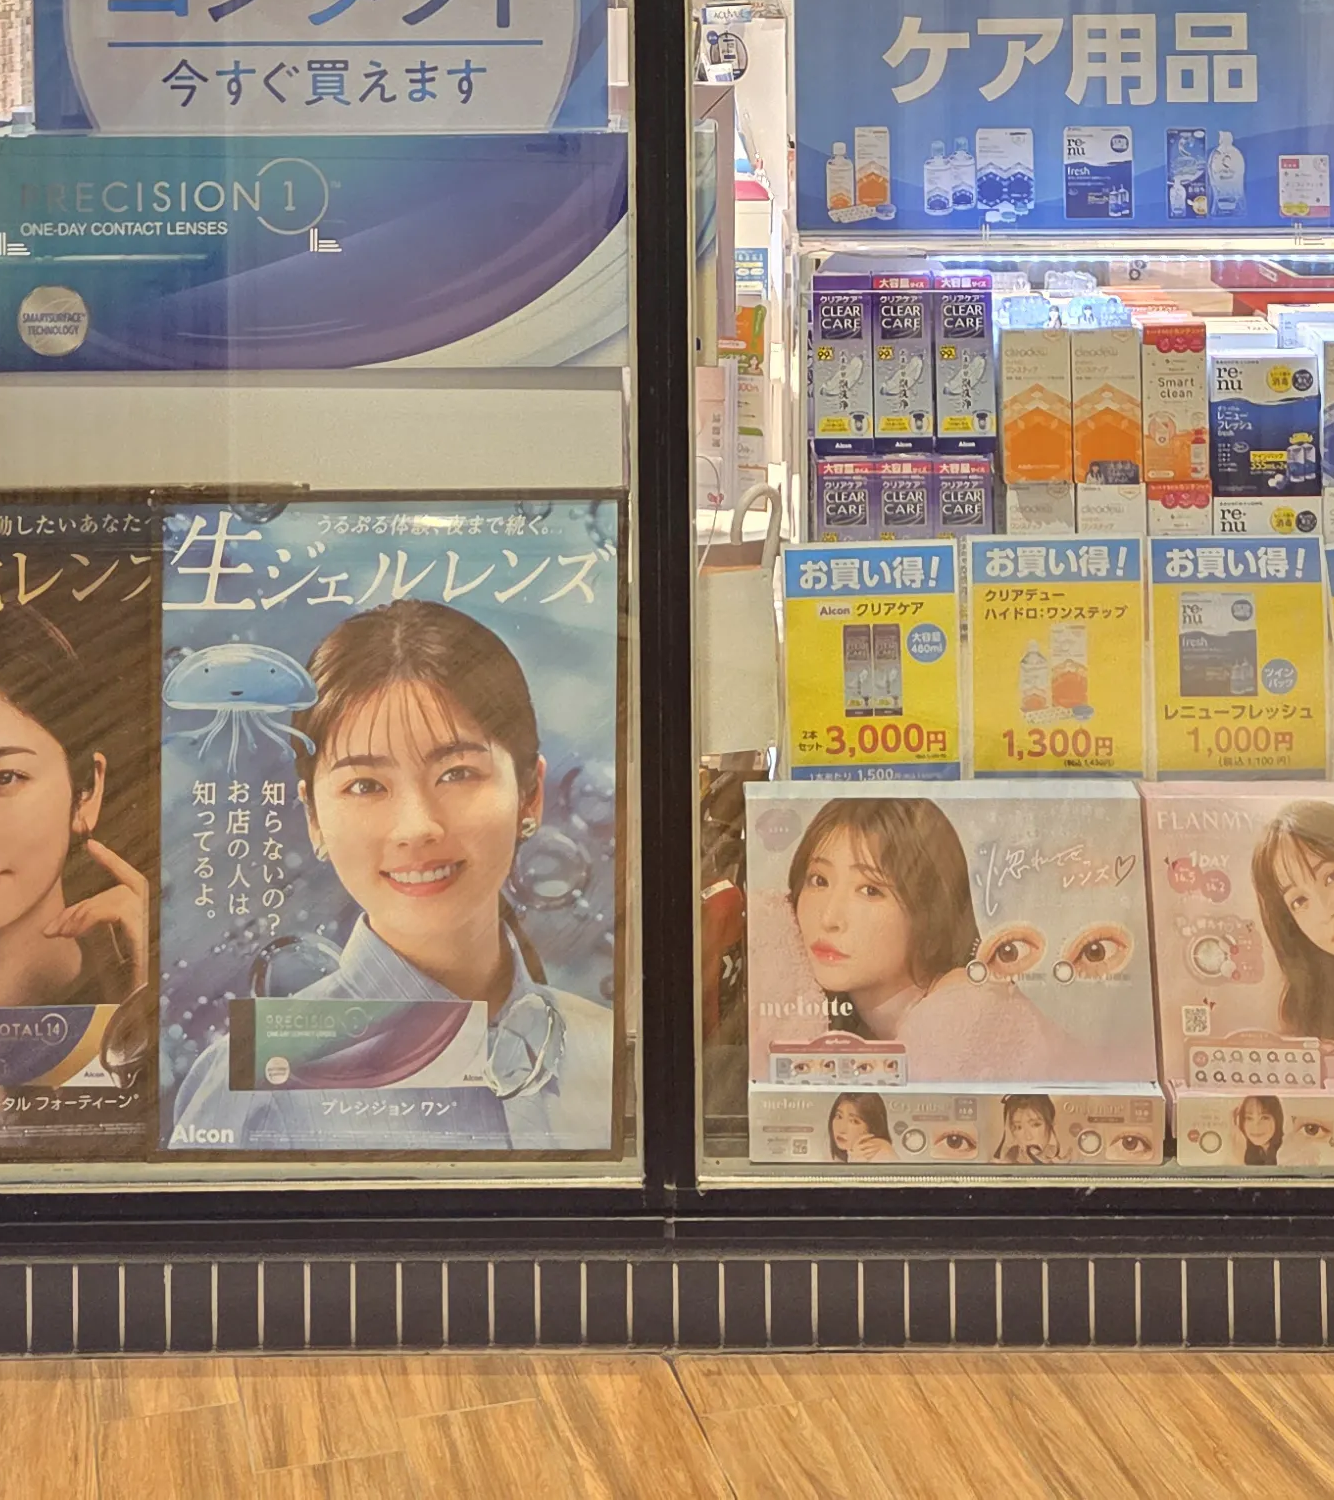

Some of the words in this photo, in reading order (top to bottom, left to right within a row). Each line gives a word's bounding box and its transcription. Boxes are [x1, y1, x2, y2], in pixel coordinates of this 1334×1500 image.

[881, 11, 1258, 106] ケア用品
[160, 58, 487, 109] 今すぐ買えます
[22, 180, 261, 213] PRECISION
[20, 221, 88, 237] ONE-DAY
[91, 221, 163, 237] CONTACT
[167, 221, 229, 236] LENSES
[821, 305, 861, 317] CLEAR
[881, 305, 921, 317] CLEAR
[943, 304, 983, 316] CLEAR
[821, 318, 862, 330] CARE
[881, 318, 922, 330] CARE
[943, 317, 984, 329] CARE
[27, 325, 80, 336] TECHNOLOGY
[1158, 377, 1195, 387] Smart
[1217, 379, 1243, 391] nu
[1160, 389, 1193, 399] clean
[826, 490, 865, 502] CLEAR
[884, 490, 923, 502] CLEAR
[942, 490, 982, 502] CLEAR
[826, 503, 865, 515] CARE
[884, 503, 923, 515] CARE
[942, 503, 982, 515] CARE
[1220, 521, 1247, 533] nu
[161, 510, 616, 611] 生ジェルレンズ
[985, 545, 1128, 579] お買い得!
[1165, 547, 1306, 579] お買い得!
[799, 555, 941, 591] お買い得!
[984, 588, 1066, 603] クリアデュー
[820, 606, 851, 616] Alcon
[856, 601, 924, 616] クリアケア
[1181, 636, 1209, 648] fresh
[1264, 667, 1295, 678] ツイン
[1267, 678, 1294, 689] パック
[1163, 703, 1314, 721] レニューフレッシュ
[802, 730, 818, 740] 2本
[825, 723, 947, 758] 3,000円
[1186, 725, 1294, 758] 1,000円
[798, 742, 823, 752] セット
[1002, 727, 1114, 762] 1,300円
[1157, 810, 1255, 832] FLANMY
[192, 779, 217, 919] 知ってるよ。
[225, 779, 251, 916] お店の人は
[261, 779, 286, 936] 知らないの?
[1189, 850, 1230, 868] 1DAY
[759, 996, 854, 1017] melotte
[321, 1101, 415, 1117] プレシジョン
[170, 1125, 235, 1145] Alcon
